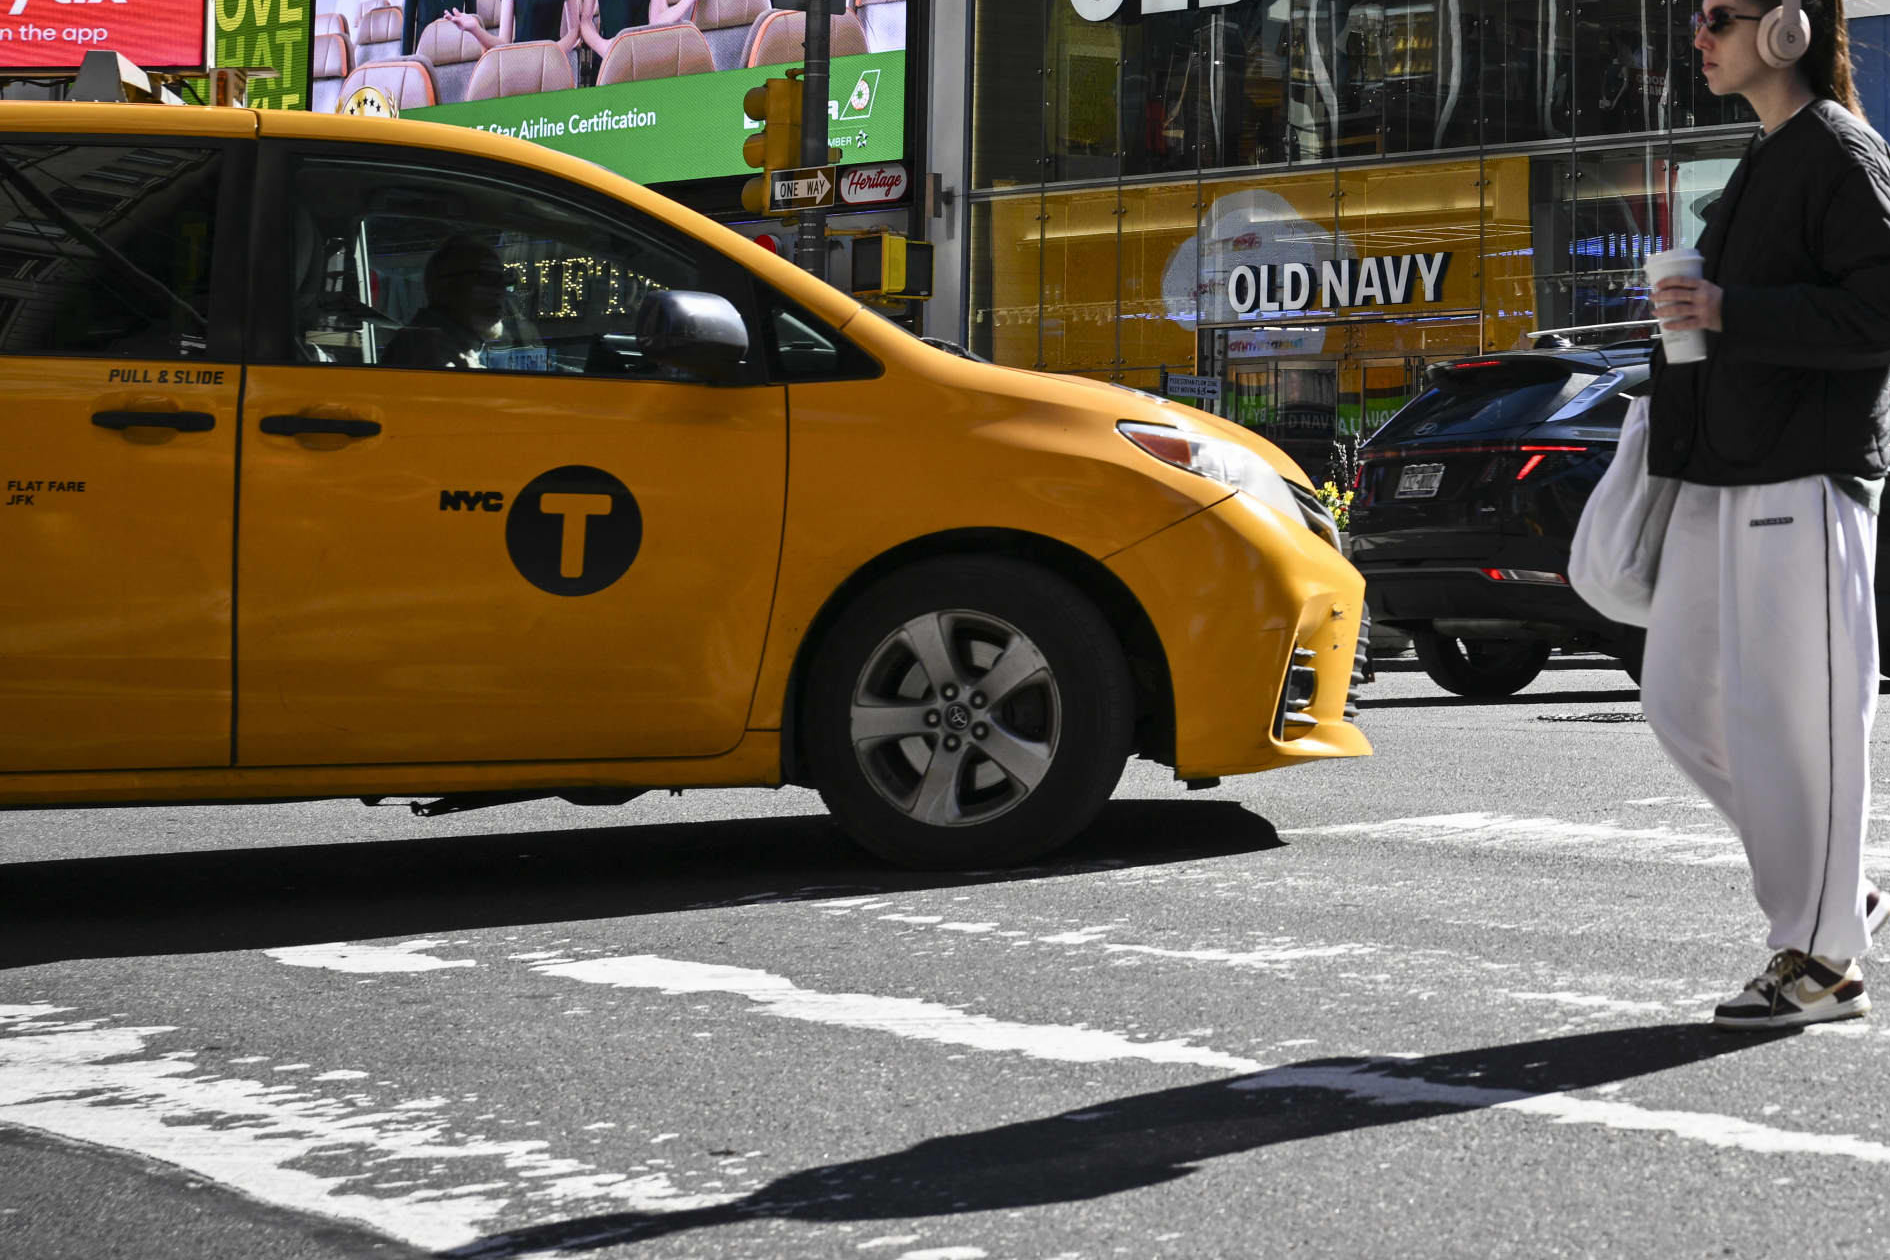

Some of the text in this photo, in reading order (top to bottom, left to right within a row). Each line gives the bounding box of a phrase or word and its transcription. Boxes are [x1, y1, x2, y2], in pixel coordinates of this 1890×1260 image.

[19, 24, 56, 42] the
[62, 29, 108, 45] app
[518, 116, 564, 140] Airline
[568, 108, 656, 135] Certification
[780, 179, 826, 199] ONE WAY
[848, 168, 903, 197] Heritage
[1228, 252, 1445, 313] OLD NAVY
[108, 369, 225, 385] PULL & SLIDE
[7, 480, 87, 493] FLAT FARE
[6, 495, 34, 506] JFK
[439, 490, 613, 579] NYC T
